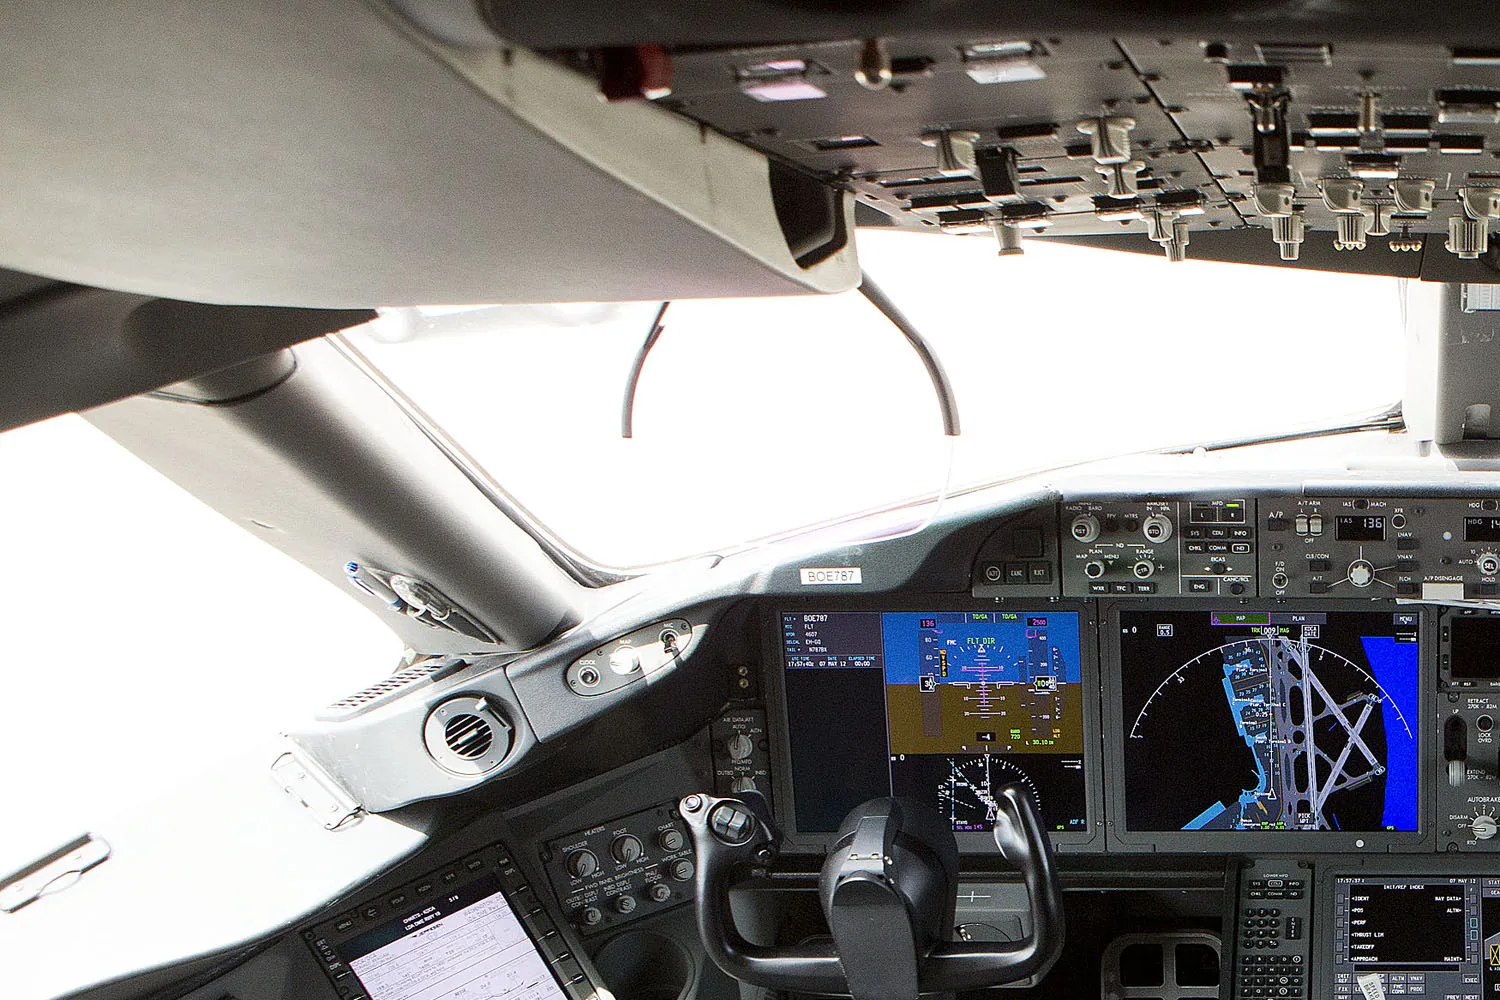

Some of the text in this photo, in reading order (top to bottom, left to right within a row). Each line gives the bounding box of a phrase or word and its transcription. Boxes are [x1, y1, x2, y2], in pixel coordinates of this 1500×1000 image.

[1363, 517, 1383, 529] 136
[808, 571, 854, 582] BOE787
[803, 614, 828, 622] BOE787
[1292, 614, 1306, 622] PLAN
